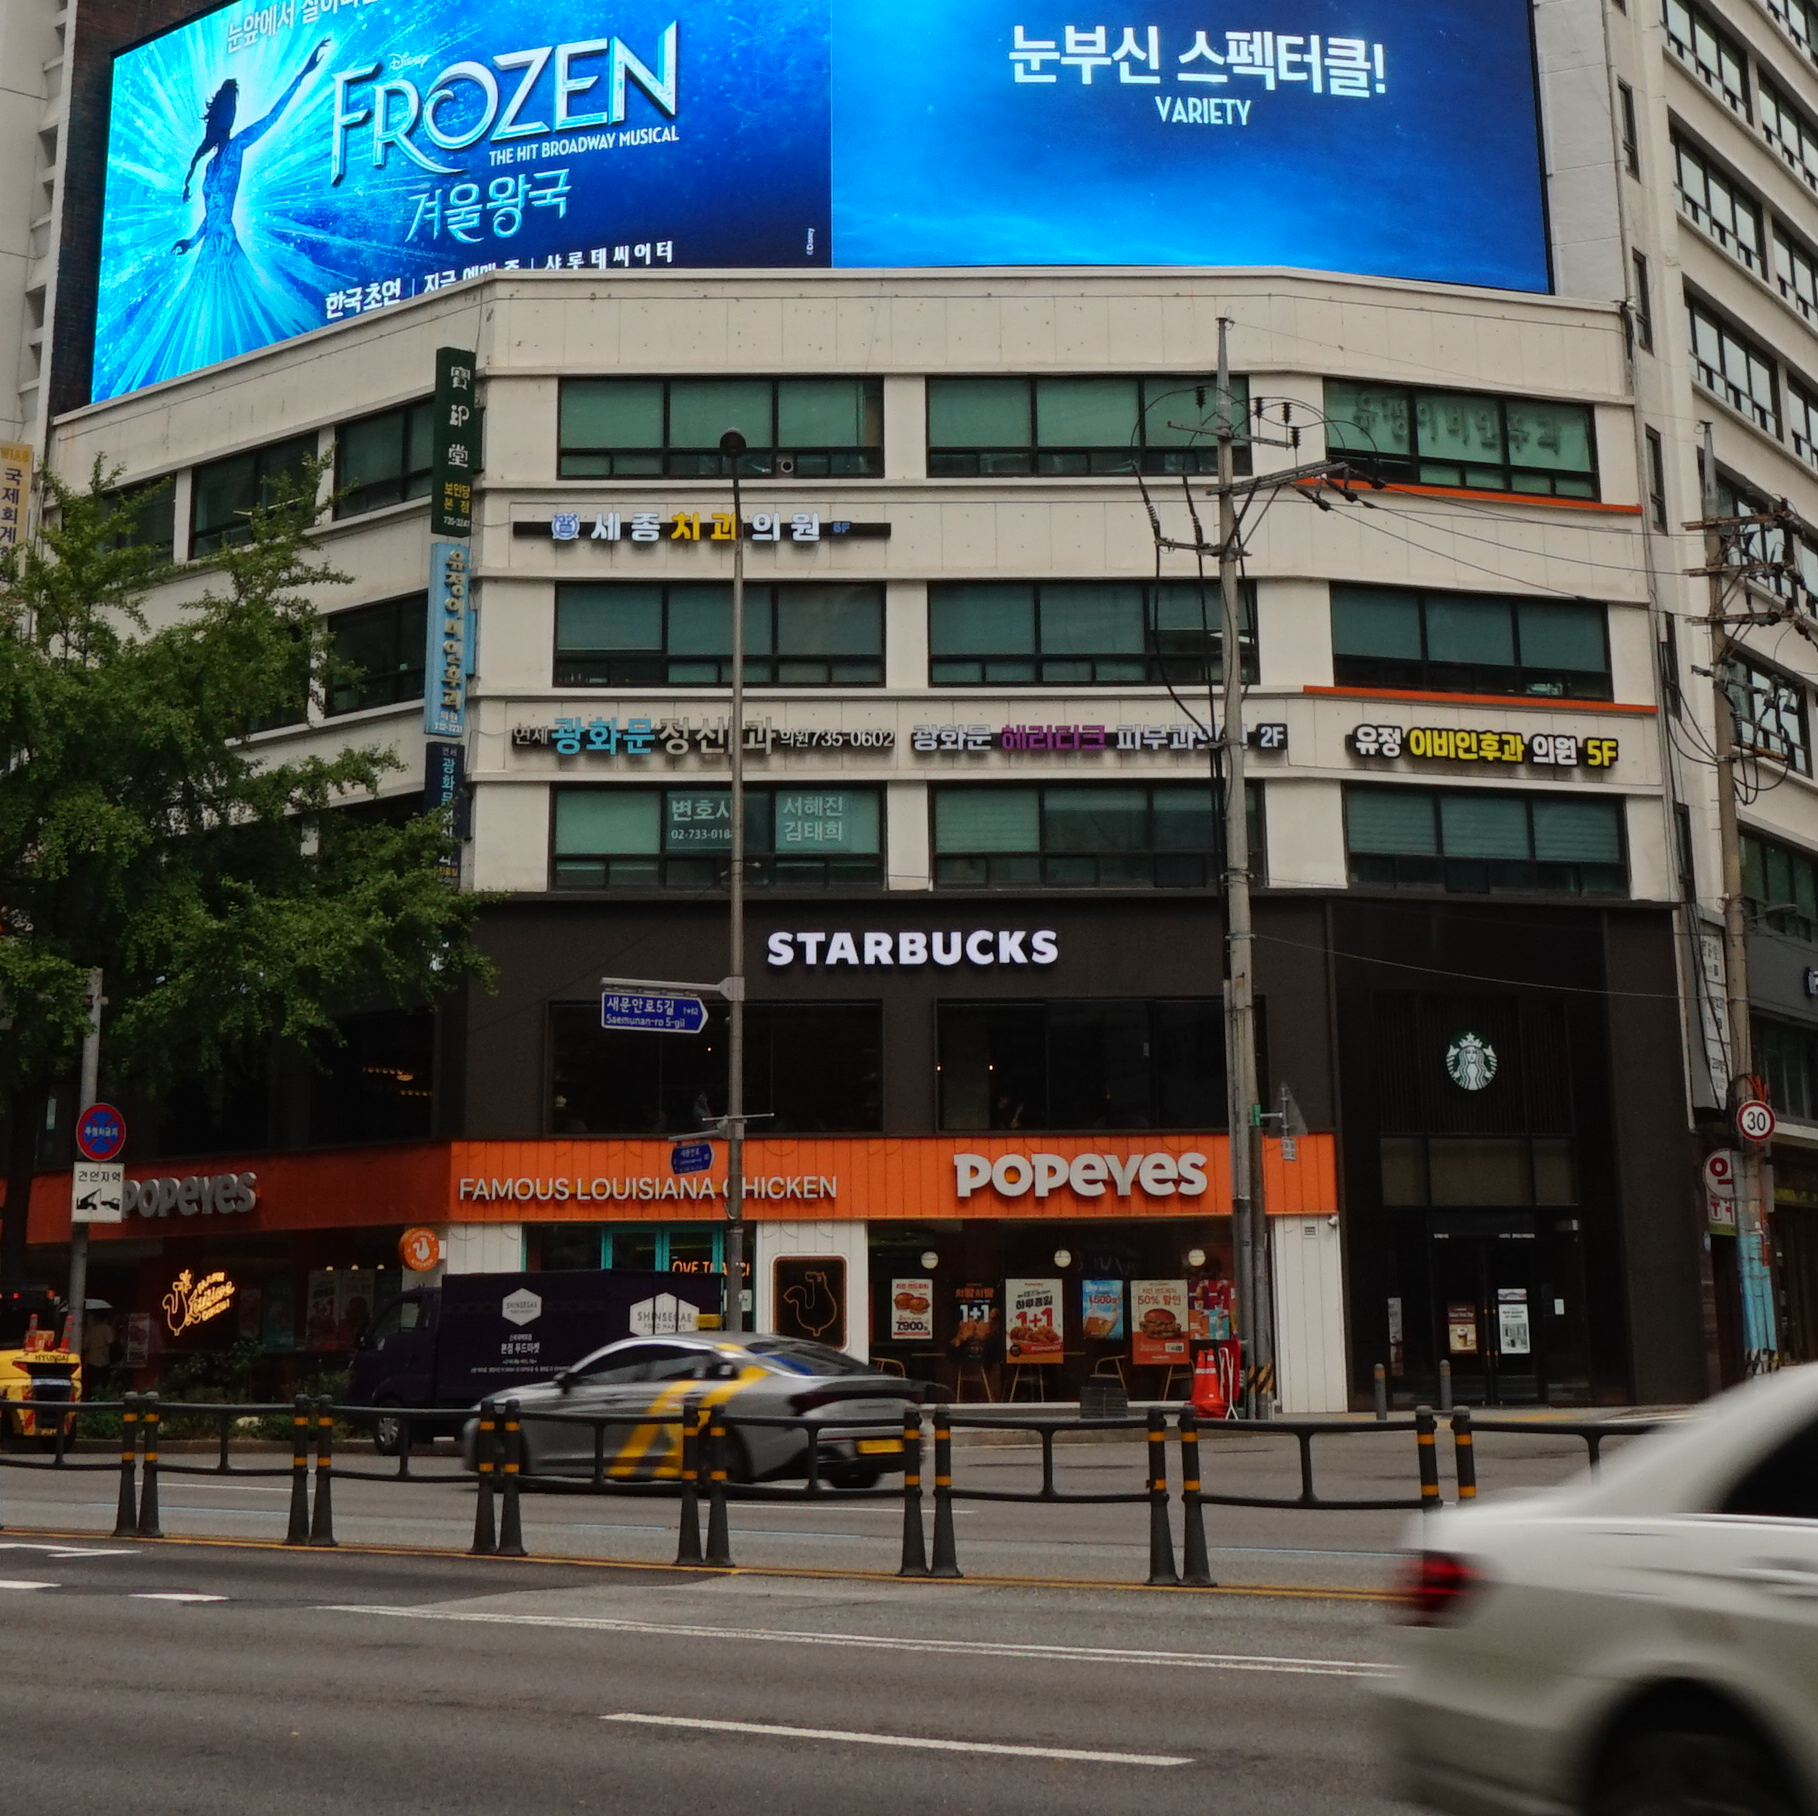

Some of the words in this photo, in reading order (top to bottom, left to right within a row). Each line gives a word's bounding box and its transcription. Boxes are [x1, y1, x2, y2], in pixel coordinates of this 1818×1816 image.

[1009, 25, 1161, 85] 눈부신
[1177, 30, 1386, 98] 스펙터클!
[330, 20, 678, 185] FROZEN
[1155, 95, 1251, 126] VARIETY
[489, 148, 515, 167] THE
[517, 144, 539, 163] HIT
[541, 134, 616, 159] BROADWAY
[619, 124, 679, 149] MUSICAL
[404, 168, 573, 244] 겨울왕국
[326, 278, 402, 319] 한국초연
[513, 725, 548, 746] 연세
[779, 728, 809, 748] 의원
[809, 728, 896, 748] 735-0602
[912, 724, 992, 752] 광화문
[1259, 725, 1285, 748] 2F
[1356, 725, 1403, 758] 유정
[1409, 727, 1525, 763] 이비인후과
[1532, 734, 1579, 767] 의원
[1587, 739, 1618, 766] 5F
[782, 795, 844, 818] 서혜진
[670, 829, 732, 841] 02-733-018
[783, 820, 843, 842] 김태희
[767, 929, 1059, 966] STARBUCKS
[606, 996, 675, 1016] 새문안로5길
[606, 1014, 665, 1027] Saemunan-ro
[1747, 1111, 1766, 1132] 30
[78, 1170, 121, 1182] 견인지역
[459, 1177, 570, 1201] FAMOUS
[576, 1176, 716, 1200] LOUISIANA
[1015, 1295, 1054, 1310] 하루종일
[1137, 1294, 1161, 1306] 50%
[960, 1303, 990, 1323] 1+1
[1015, 1307, 1054, 1328] 1+1
